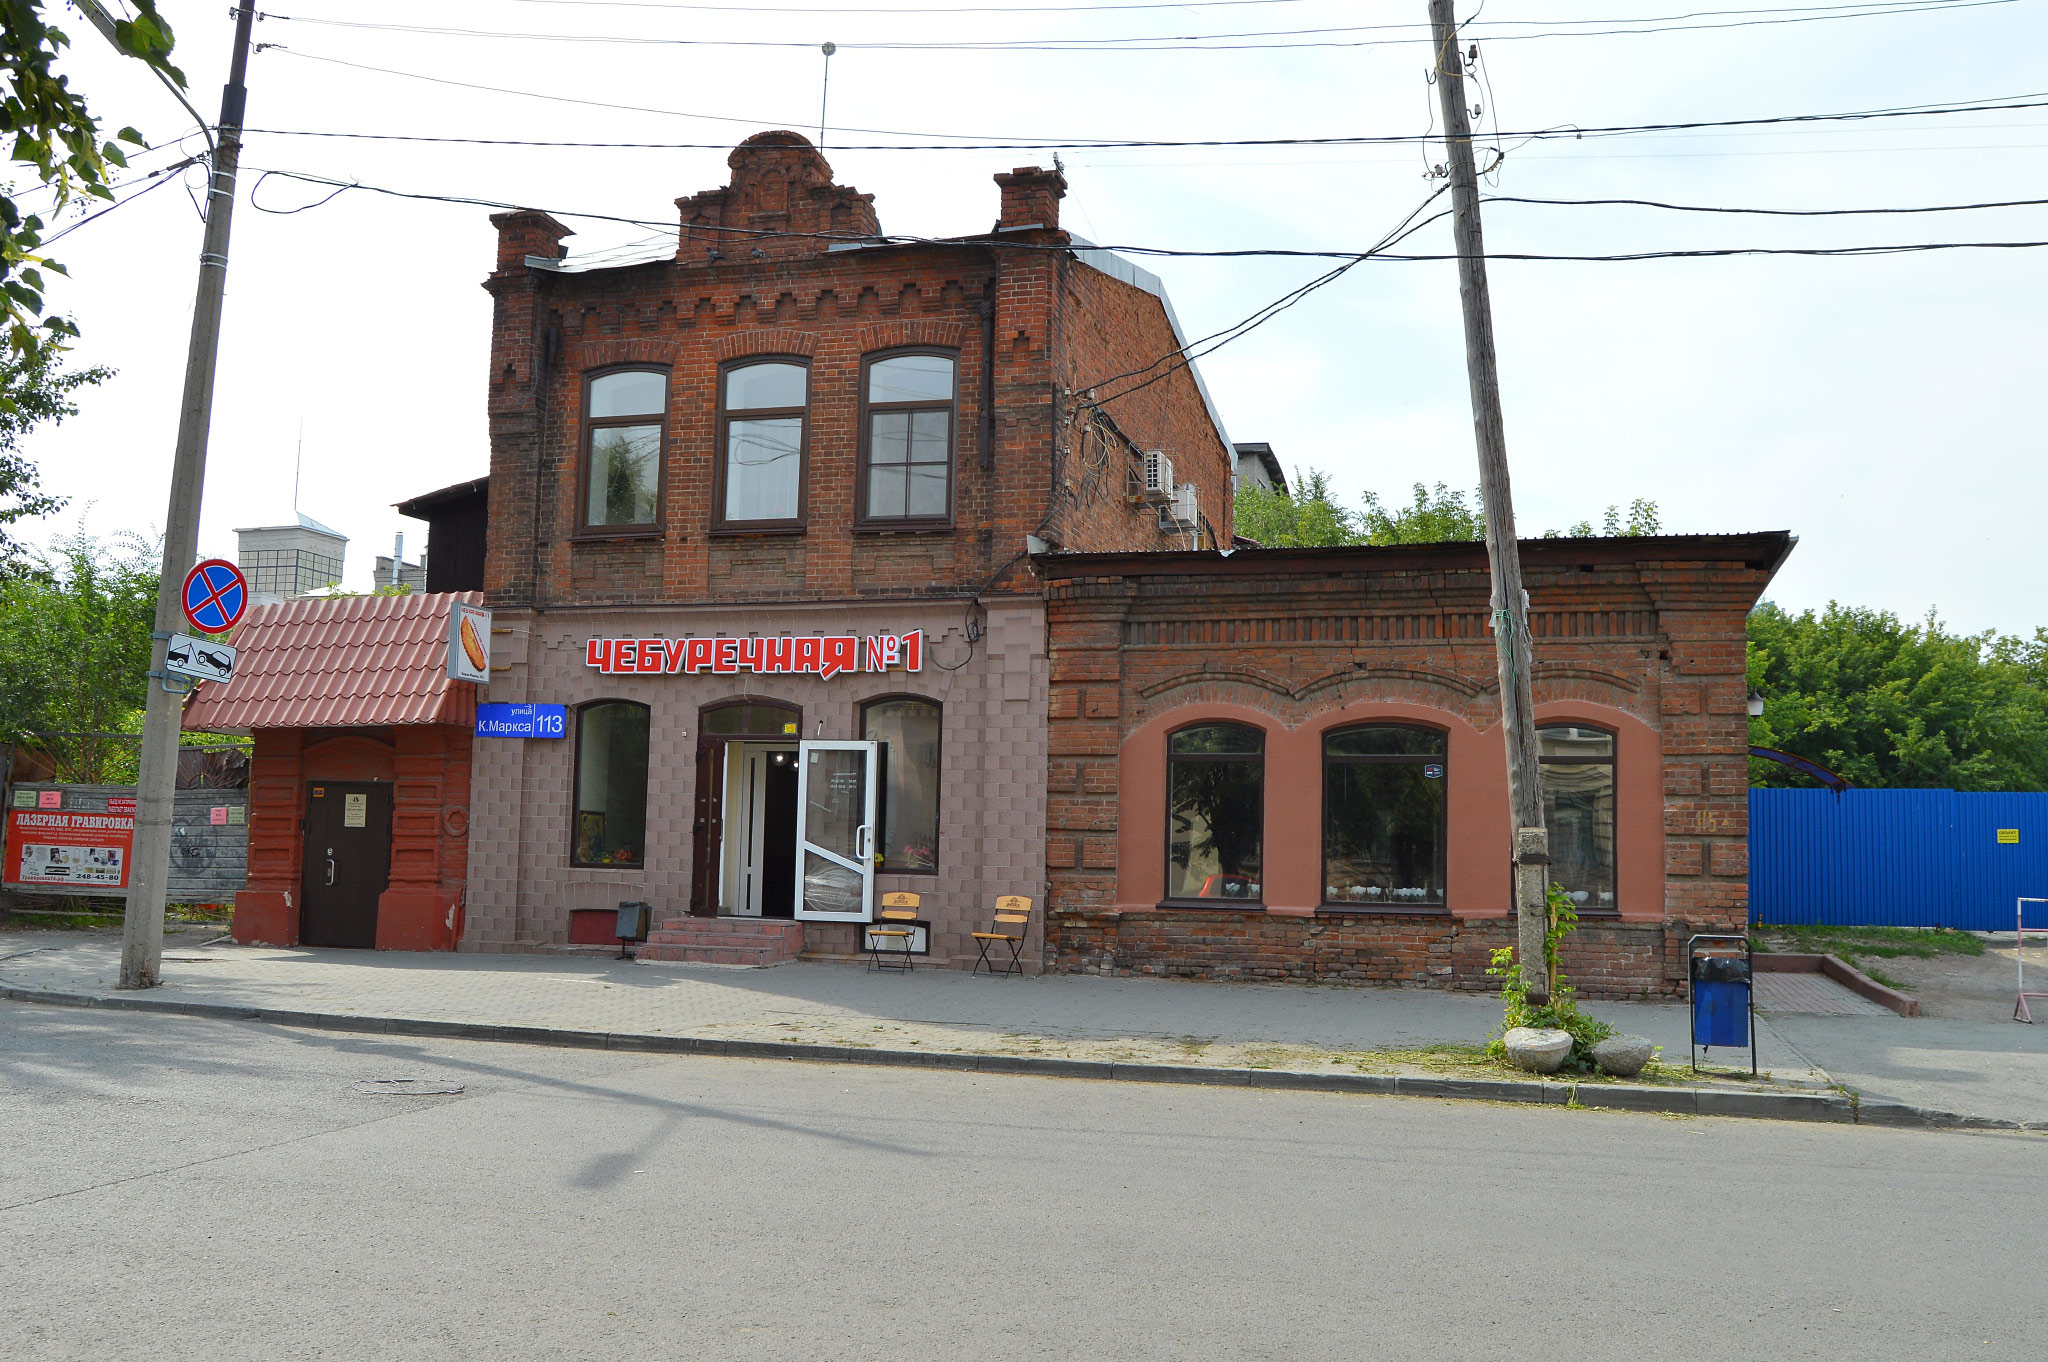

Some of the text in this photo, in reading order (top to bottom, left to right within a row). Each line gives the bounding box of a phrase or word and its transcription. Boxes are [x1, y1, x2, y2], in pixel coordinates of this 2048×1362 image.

[586, 629, 923, 681] ЧЕБУРЕЧНАЯ №1
[511, 708, 533, 716] улица
[478, 720, 532, 734] К.Маркса
[536, 715, 563, 733] 113
[16, 813, 69, 827] ЛАЗЕРНАЯ
[70, 815, 134, 830] ГРАВИРОВКА
